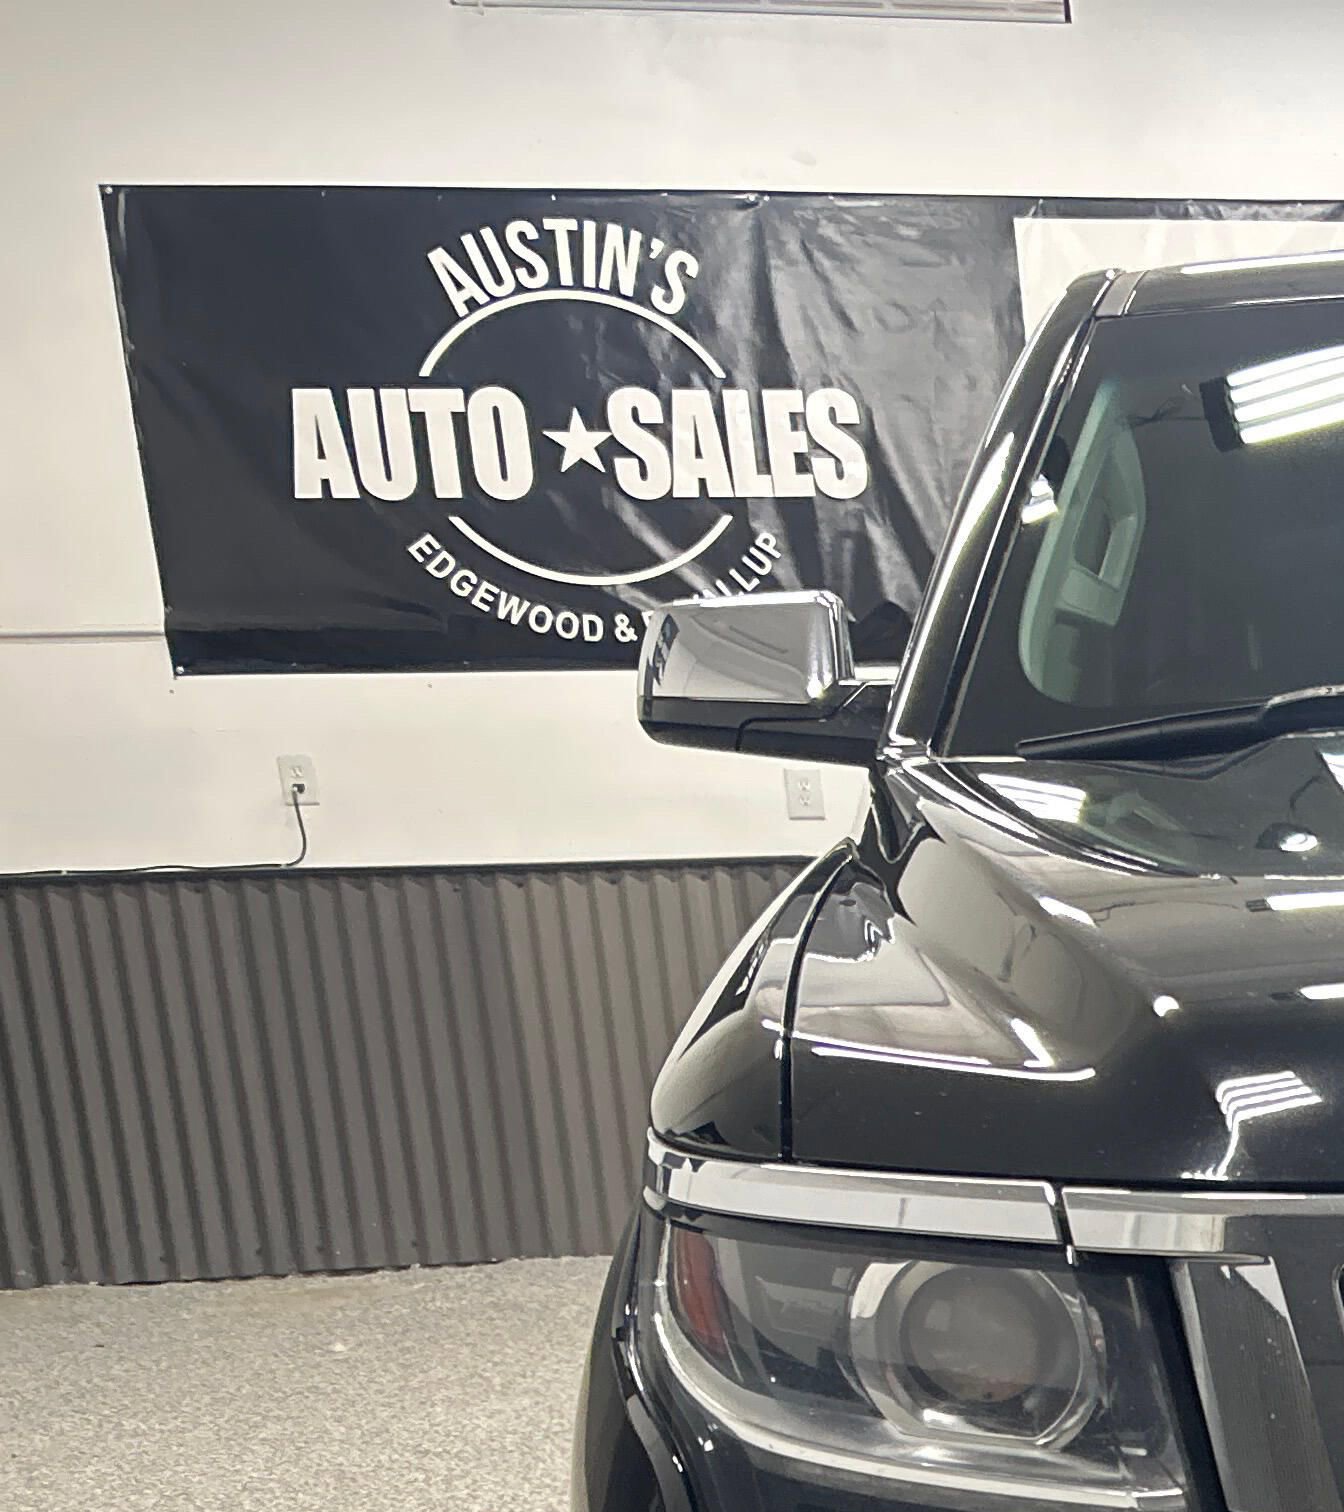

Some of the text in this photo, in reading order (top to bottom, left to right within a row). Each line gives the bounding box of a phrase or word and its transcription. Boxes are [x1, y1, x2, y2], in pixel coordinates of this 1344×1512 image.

[426, 216, 700, 317] AUSTIN'S
[291, 386, 868, 501] AUTO SALES
[407, 532, 604, 642] EDGEWOOD
[614, 613, 638, 642] &
